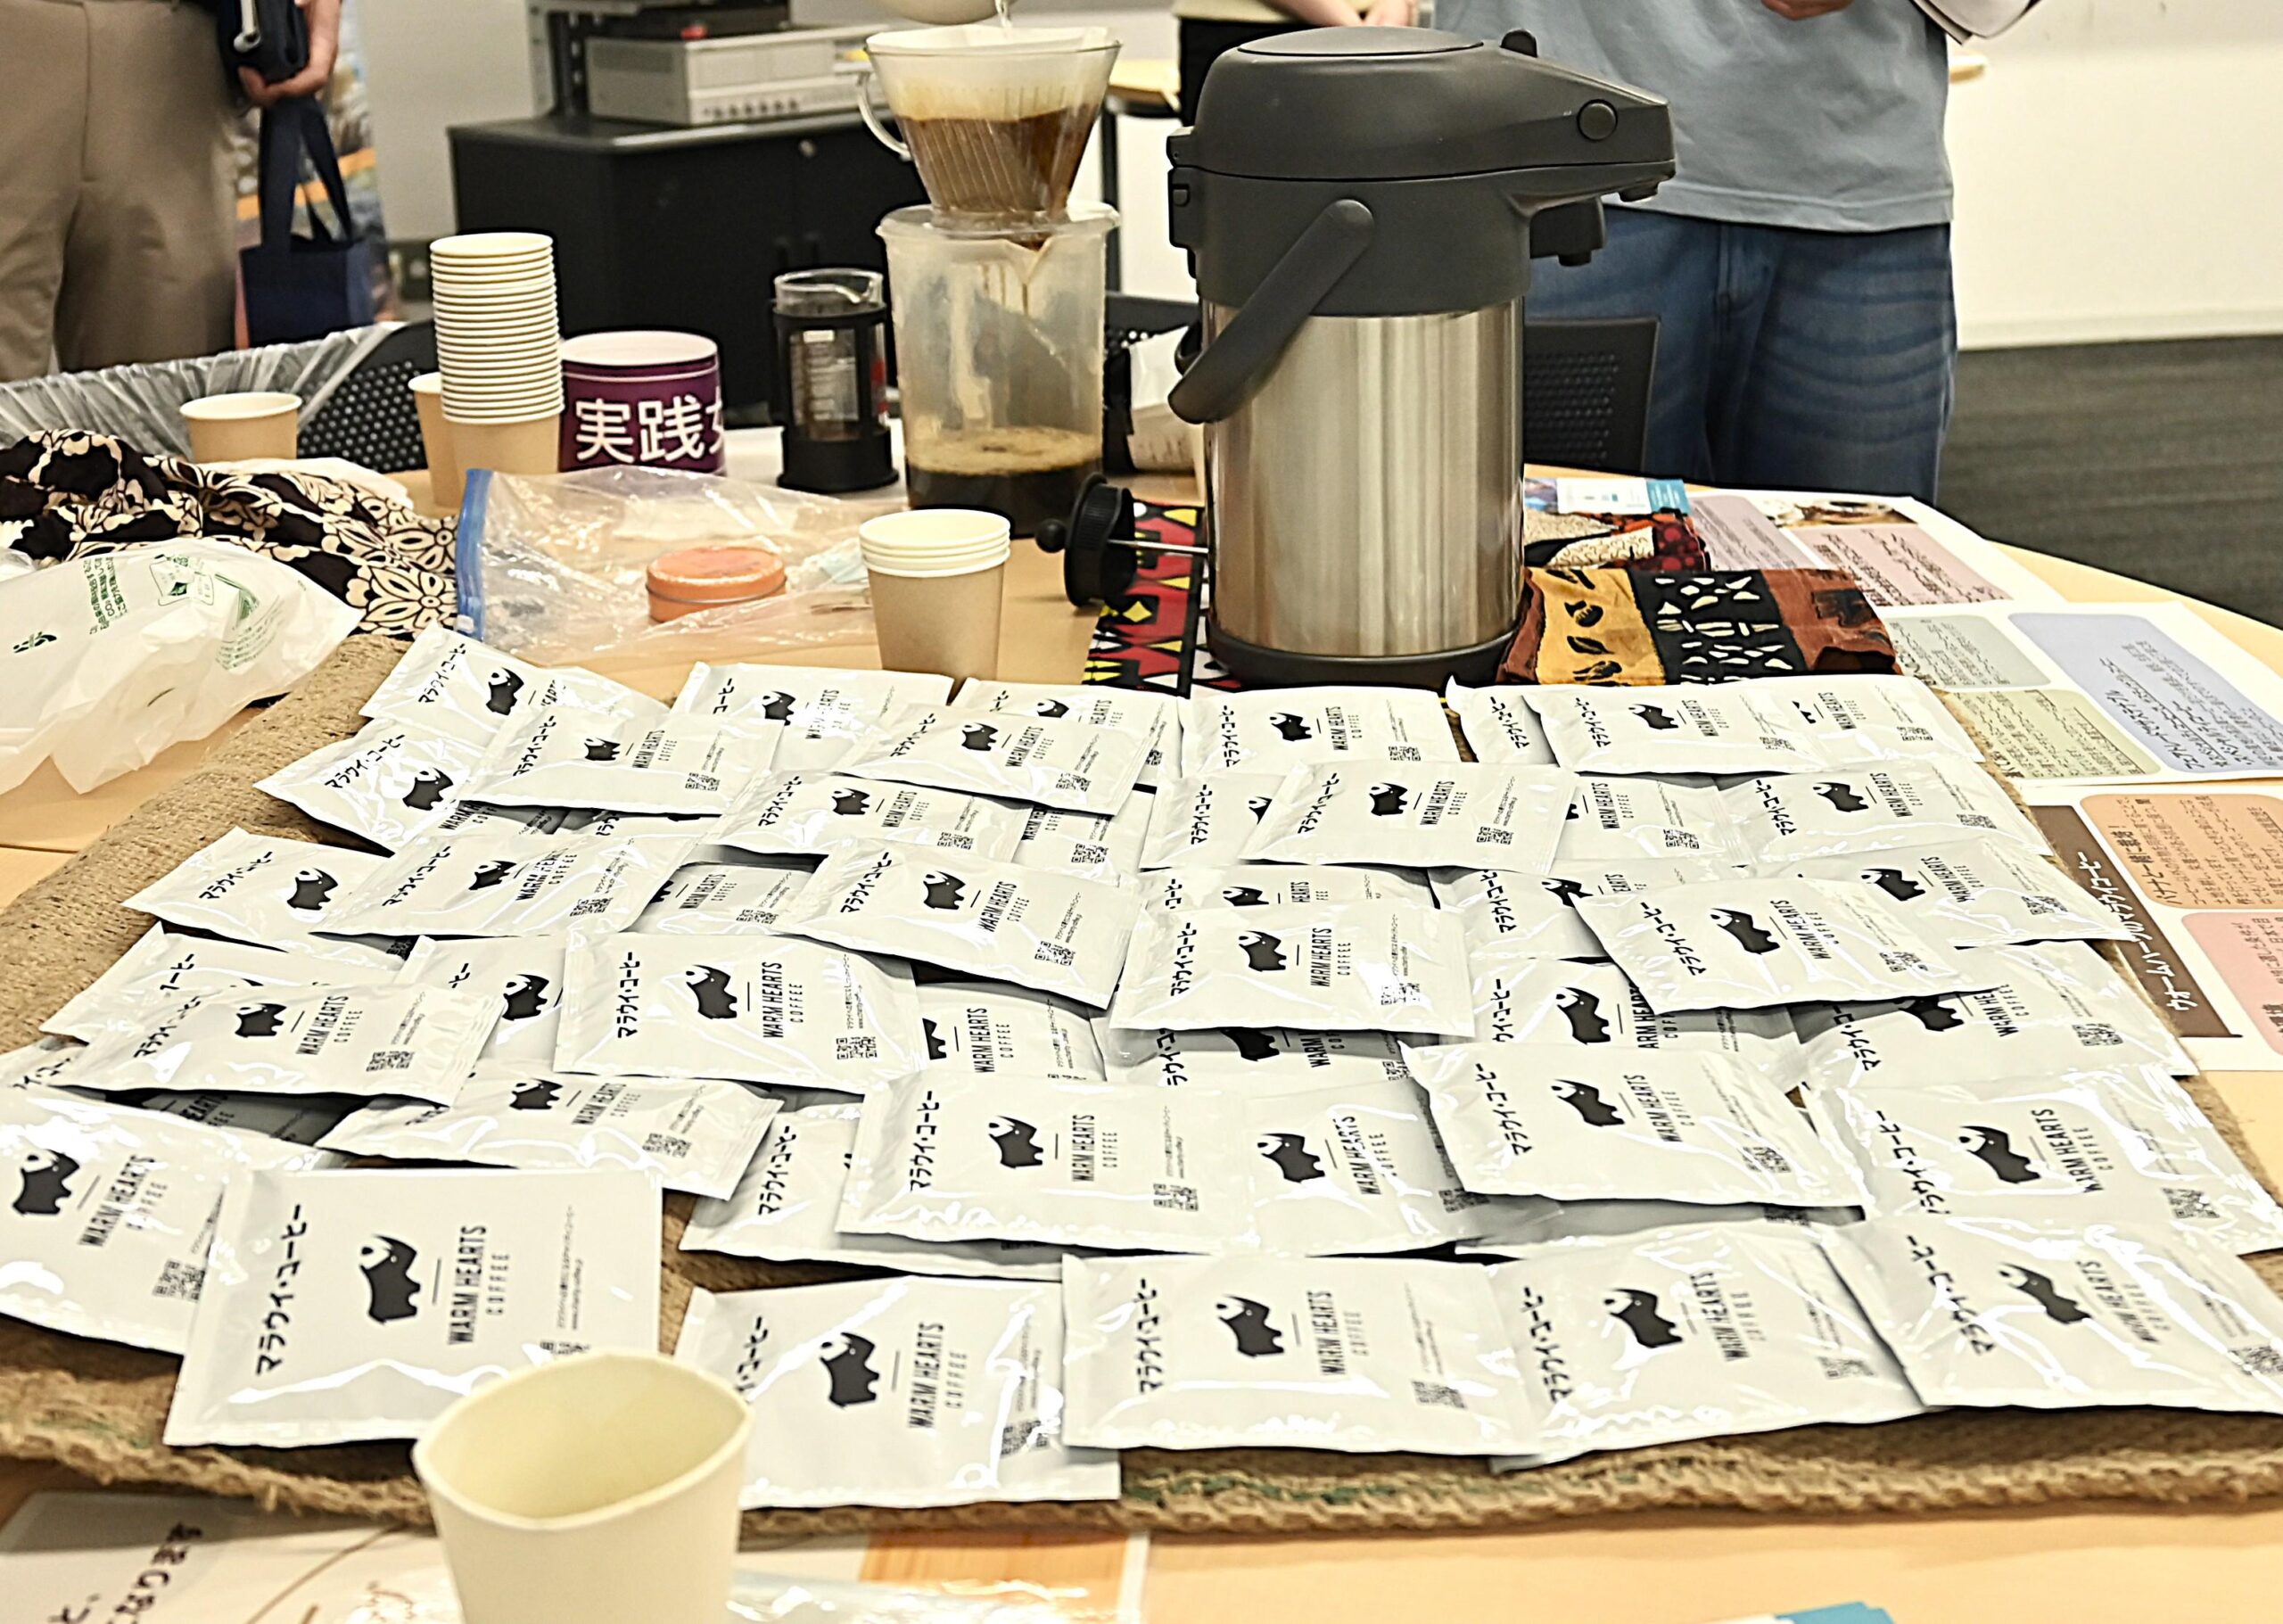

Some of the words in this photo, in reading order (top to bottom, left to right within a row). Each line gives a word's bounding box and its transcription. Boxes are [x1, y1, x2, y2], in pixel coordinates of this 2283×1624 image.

[1222, 705, 1240, 768] マラウイ・コーヒー
[1325, 706, 1345, 730] HEARTS
[1348, 714, 1362, 738] COFFEE
[1005, 745, 1027, 767] WARM
[1019, 726, 1044, 746] HEARTS
[1033, 738, 1054, 760] COFFEE
[1331, 729, 1348, 750] WARM
[758, 776, 802, 827] マラウイ・コーヒー
[1430, 781, 1455, 805] HEARTS
[1447, 792, 1468, 815] COFFEE
[1591, 783, 1614, 810] HEARTS
[1870, 773, 1903, 803] HEARTS
[1191, 784, 1213, 845] マラウイ・コーヒー
[1421, 803, 1443, 825] WARM
[1597, 808, 1620, 829] WARM
[1616, 795, 1634, 819] COFFEE
[1887, 799, 1914, 818] WARM
[548, 853, 577, 886] COFFEE
[840, 851, 892, 913] マラウイ・コーヒー
[1921, 856, 1956, 883] HEARTS
[978, 905, 1003, 932] WARM
[993, 881, 1018, 910] HEARTS
[1007, 896, 1029, 922] COFFEE
[1311, 927, 1332, 960] HEARTS
[1640, 902, 1707, 976] マラウイ・コーヒー
[1802, 932, 1832, 960] WARM
[1170, 922, 1197, 996] マラウイ・コーヒー
[1311, 960, 1331, 987] WARM
[1338, 942, 1351, 976] COFFEE
[617, 952, 640, 1039] マラウイ・コーヒー
[762, 961, 783, 1003] HEARTS
[312, 995, 349, 1028] HEARTS
[763, 1002, 784, 1038] WARM
[790, 983, 804, 1023] COFFEE
[1983, 1004, 2019, 1037] WARM
[295, 1023, 330, 1055] WARM
[334, 1010, 363, 1043] COFFEE
[967, 1008, 991, 1046] HEARTS
[996, 1023, 1014, 1059] COFFEE
[1475, 1062, 1533, 1157] マラウイ・コーヒー
[1623, 1074, 1664, 1116] HEARTS
[1661, 1090, 1695, 1127] COFFEE
[910, 1091, 939, 1191] マラウイ・コーヒー
[1072, 1115, 1094, 1152] HEARTS
[1647, 1110, 1684, 1142] WARM
[2031, 1109, 2076, 1161] HEARTS
[1072, 1151, 1094, 1182] WARM
[1102, 1132, 1117, 1168] COFFEE
[759, 1125, 796, 1216] マラウイ・コーヒー
[1348, 1158, 1381, 1195] WARM
[455, 1224, 487, 1289] HEARTS
[257, 1204, 306, 1376] マラウイ・コーヒー
[486, 1253, 510, 1315] COFFEE
[448, 1293, 479, 1345] WARM
[1306, 1290, 1340, 1335] HEARTS
[914, 1322, 945, 1381] HEARTS
[1313, 1334, 1347, 1375] WARM
[945, 1350, 968, 1410] COFFEE
[909, 1381, 936, 1429] WARM
